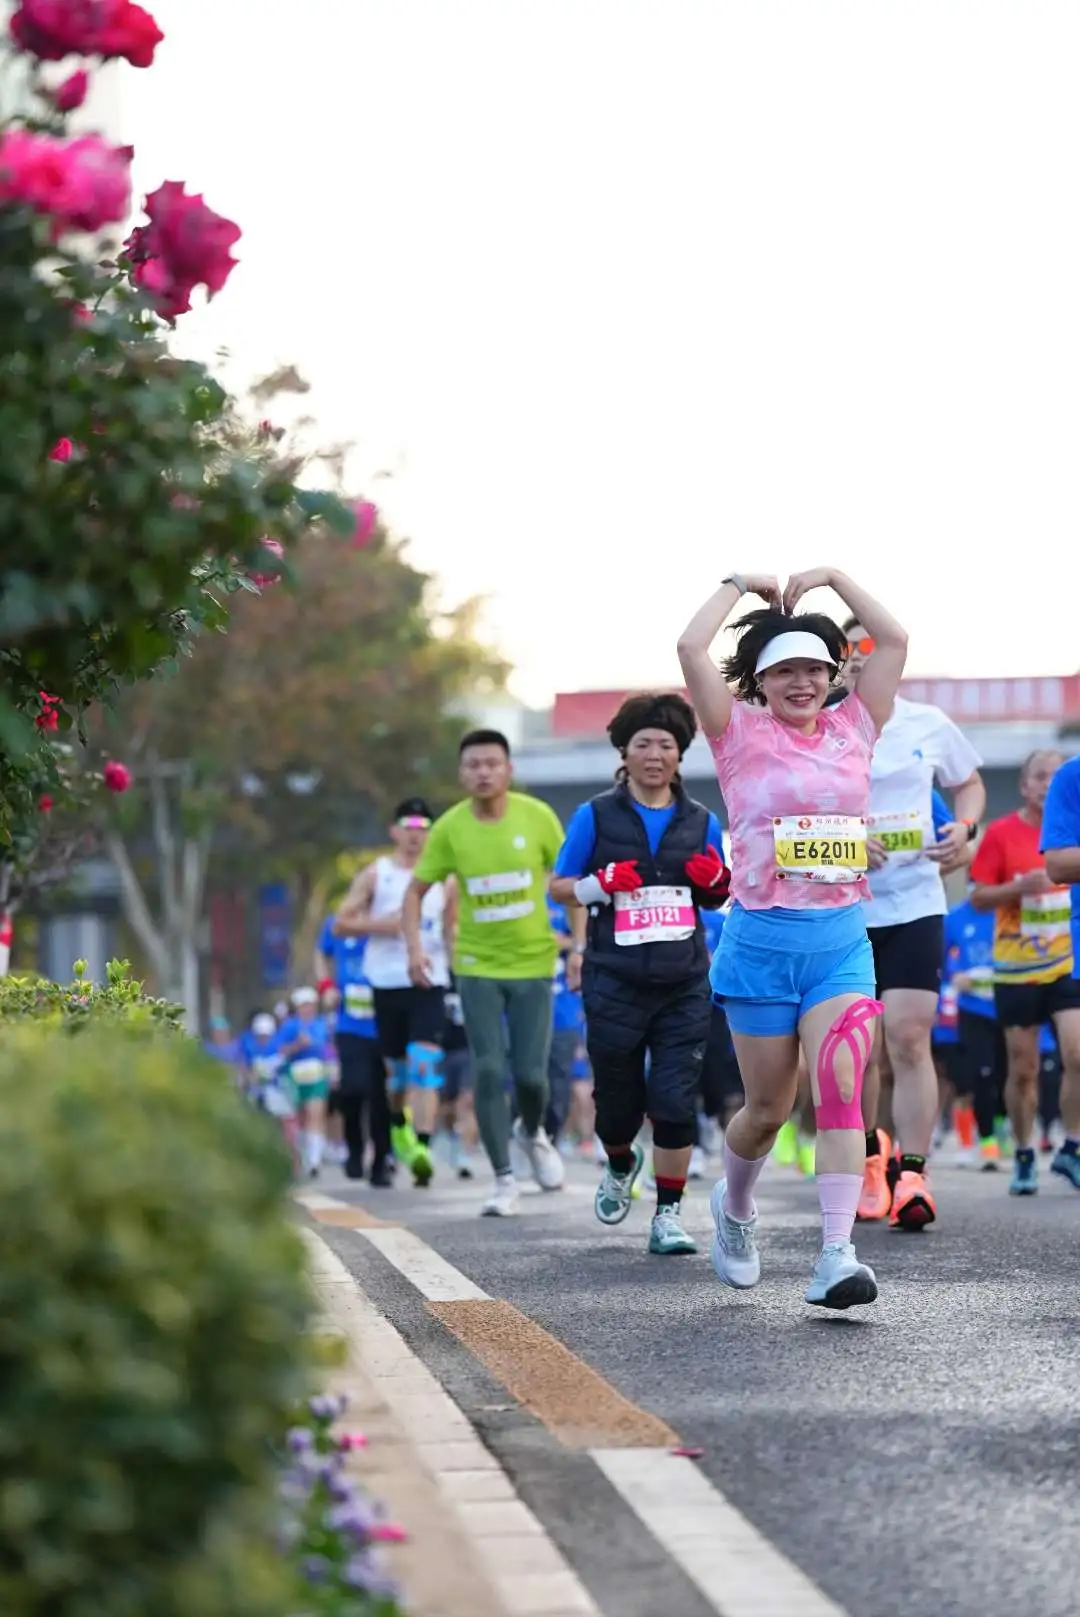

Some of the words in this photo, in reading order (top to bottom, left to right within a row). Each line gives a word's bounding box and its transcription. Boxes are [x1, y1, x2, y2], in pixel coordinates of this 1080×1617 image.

[873, 831, 914, 847] 5361
[793, 841, 856, 860] E62011
[629, 906, 680, 927] F31121
